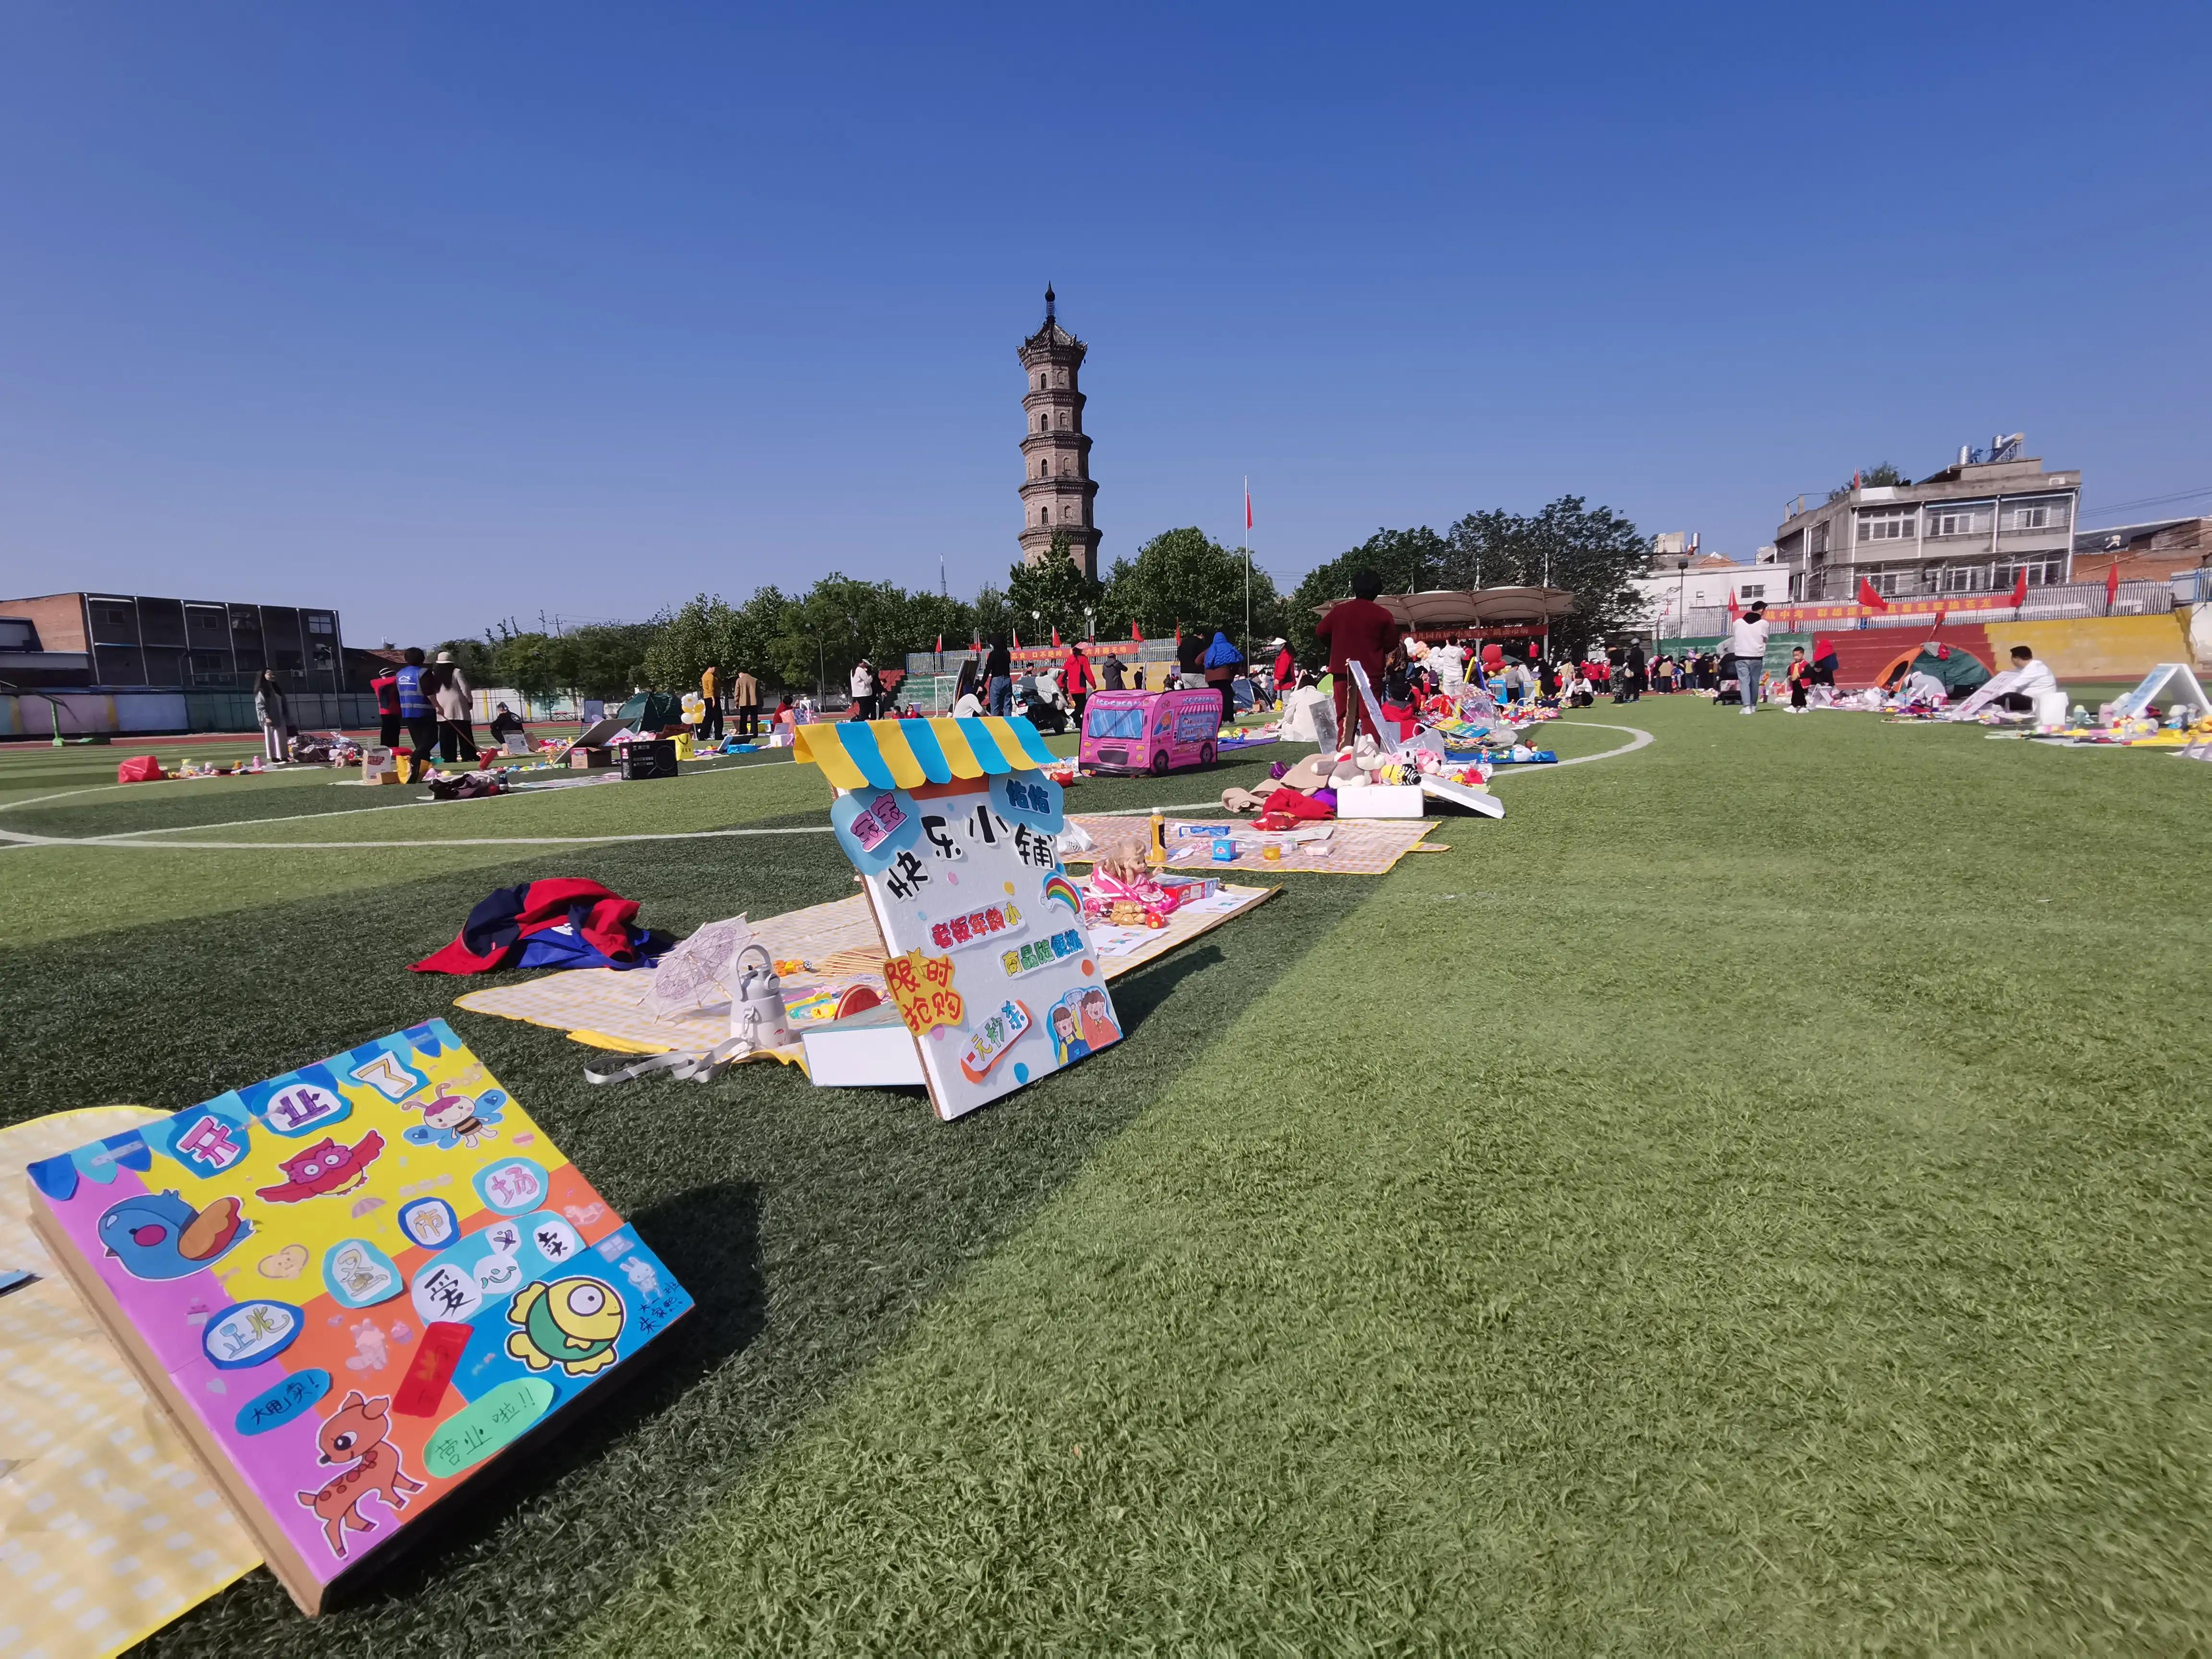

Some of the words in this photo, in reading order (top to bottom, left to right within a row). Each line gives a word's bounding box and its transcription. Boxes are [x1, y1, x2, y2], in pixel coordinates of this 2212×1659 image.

[850, 792, 909, 851] 宝宝
[887, 805, 1054, 900] 快乐小铺
[931, 902, 1022, 949] 老板年龄小
[1002, 928, 1084, 977] 商品随便挑
[885, 956, 953, 1001] 限时
[902, 990, 961, 1032] 抢购
